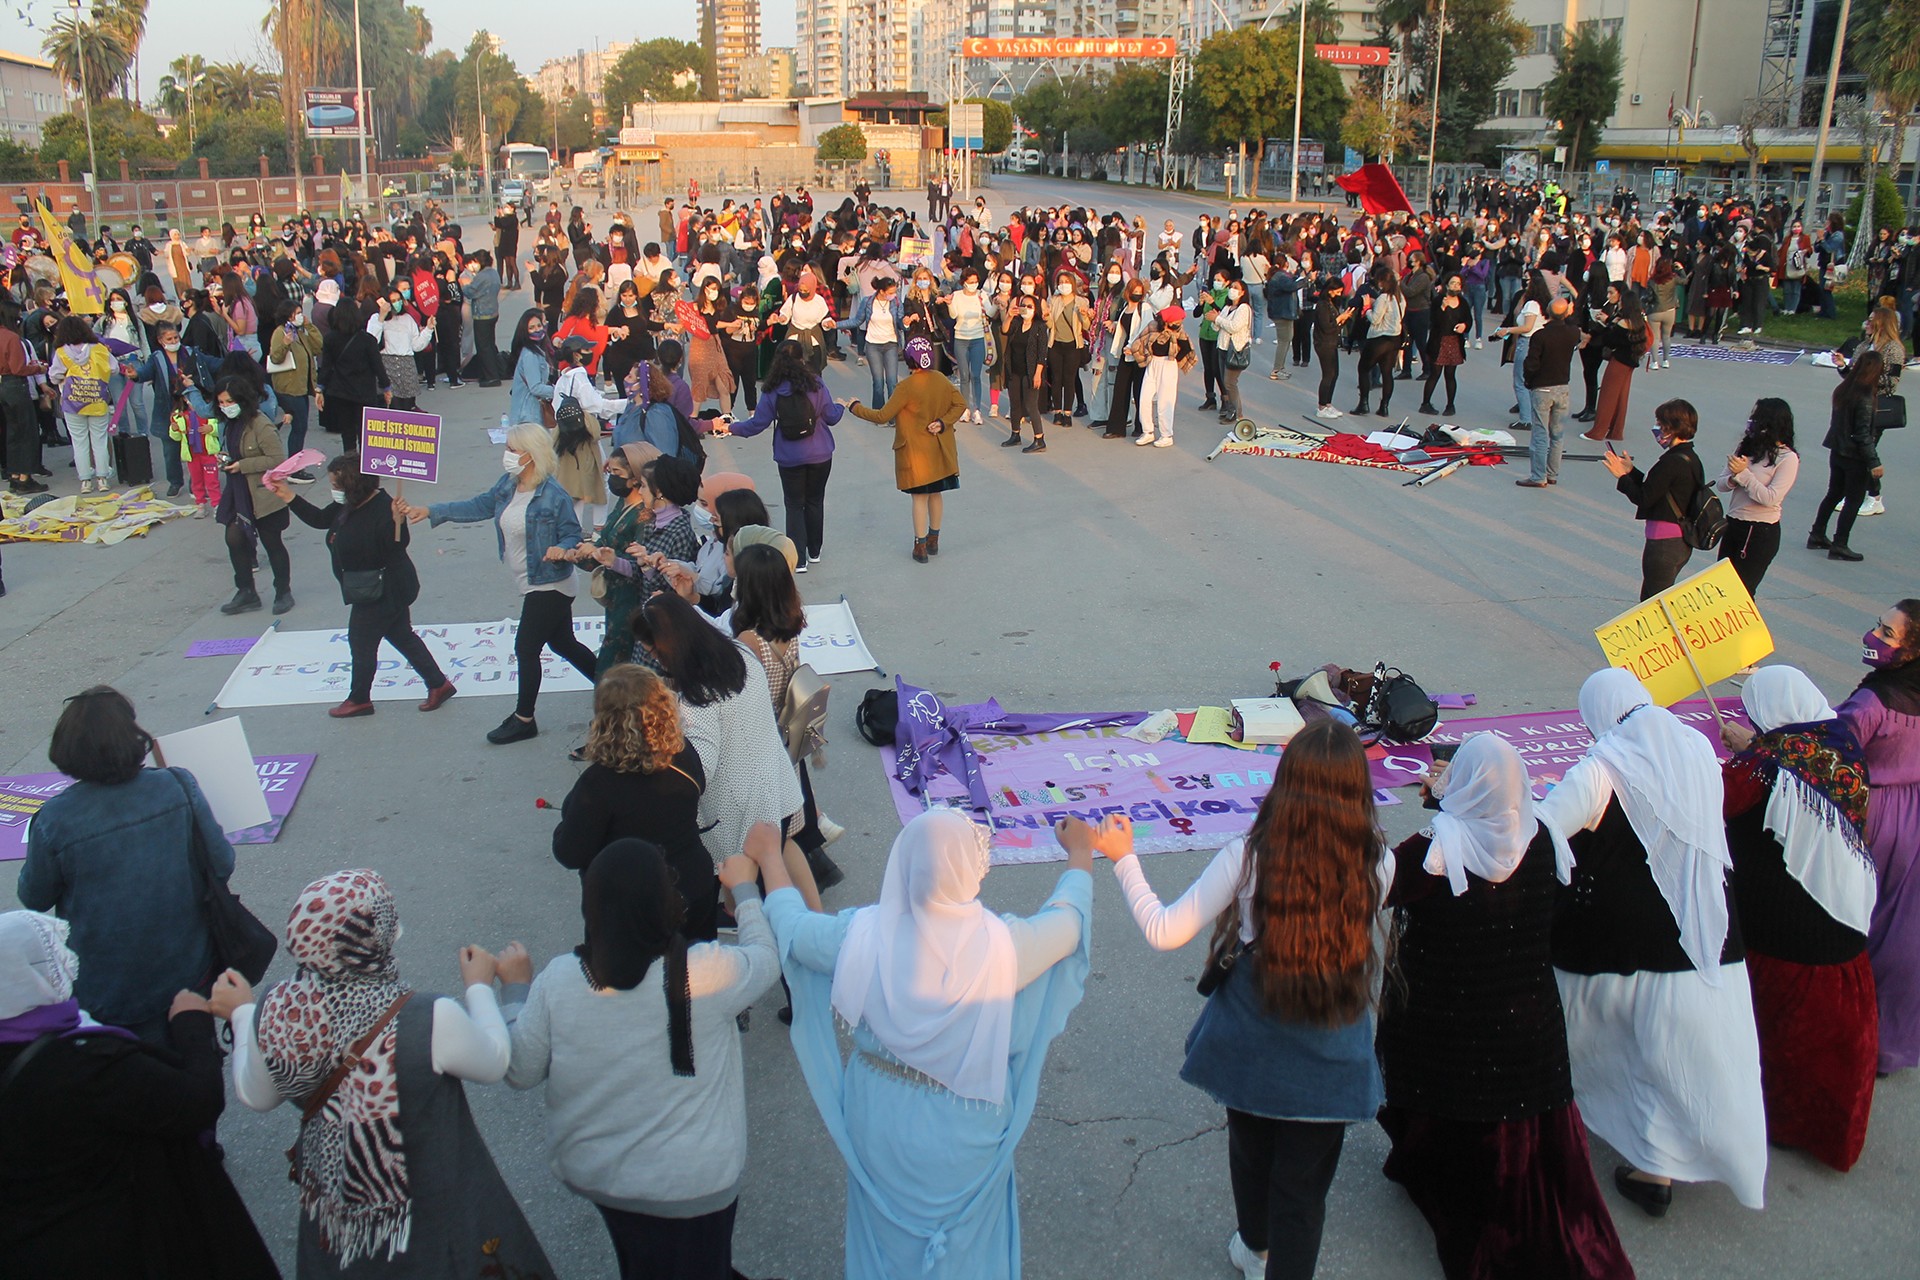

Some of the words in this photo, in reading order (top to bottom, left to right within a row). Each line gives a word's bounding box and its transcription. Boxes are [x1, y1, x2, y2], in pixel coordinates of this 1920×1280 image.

[997, 43, 1051, 56] YAŞASIN
[1056, 41, 1144, 54] CUMHURİYET
[367, 419, 386, 433] EVDE
[387, 419, 403, 436] İŞTE
[403, 423, 436, 439] SOKAKTA
[367, 434, 405, 451] KADINLAR
[405, 437, 436, 455] İSYANDA
